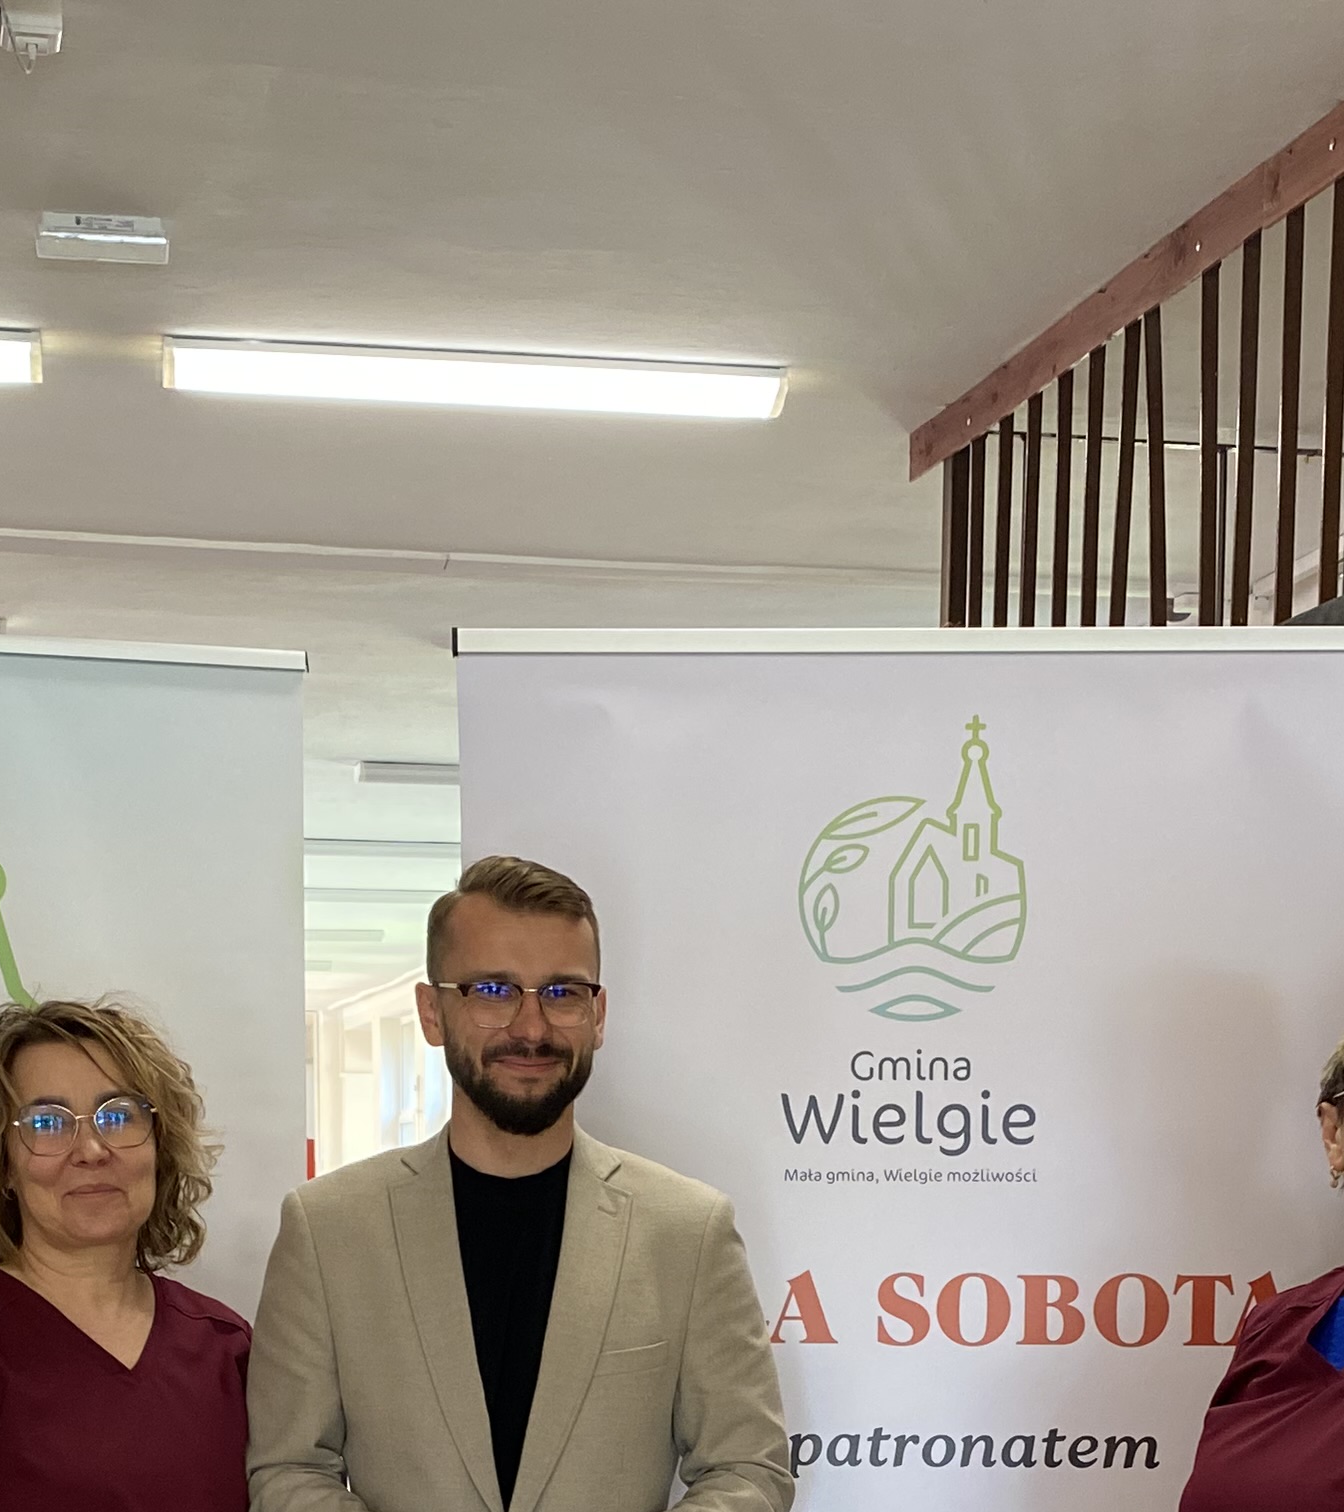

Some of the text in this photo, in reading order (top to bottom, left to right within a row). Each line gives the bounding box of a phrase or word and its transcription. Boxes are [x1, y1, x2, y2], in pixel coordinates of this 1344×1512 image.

[850, 1048, 971, 1081] Gmina
[780, 1089, 1037, 1156] Wielgie
[784, 1167, 1038, 1184] Mała gmina, Wielgie możliwości
[766, 1269, 838, 1344] A
[789, 1426, 1160, 1479] patronatem
